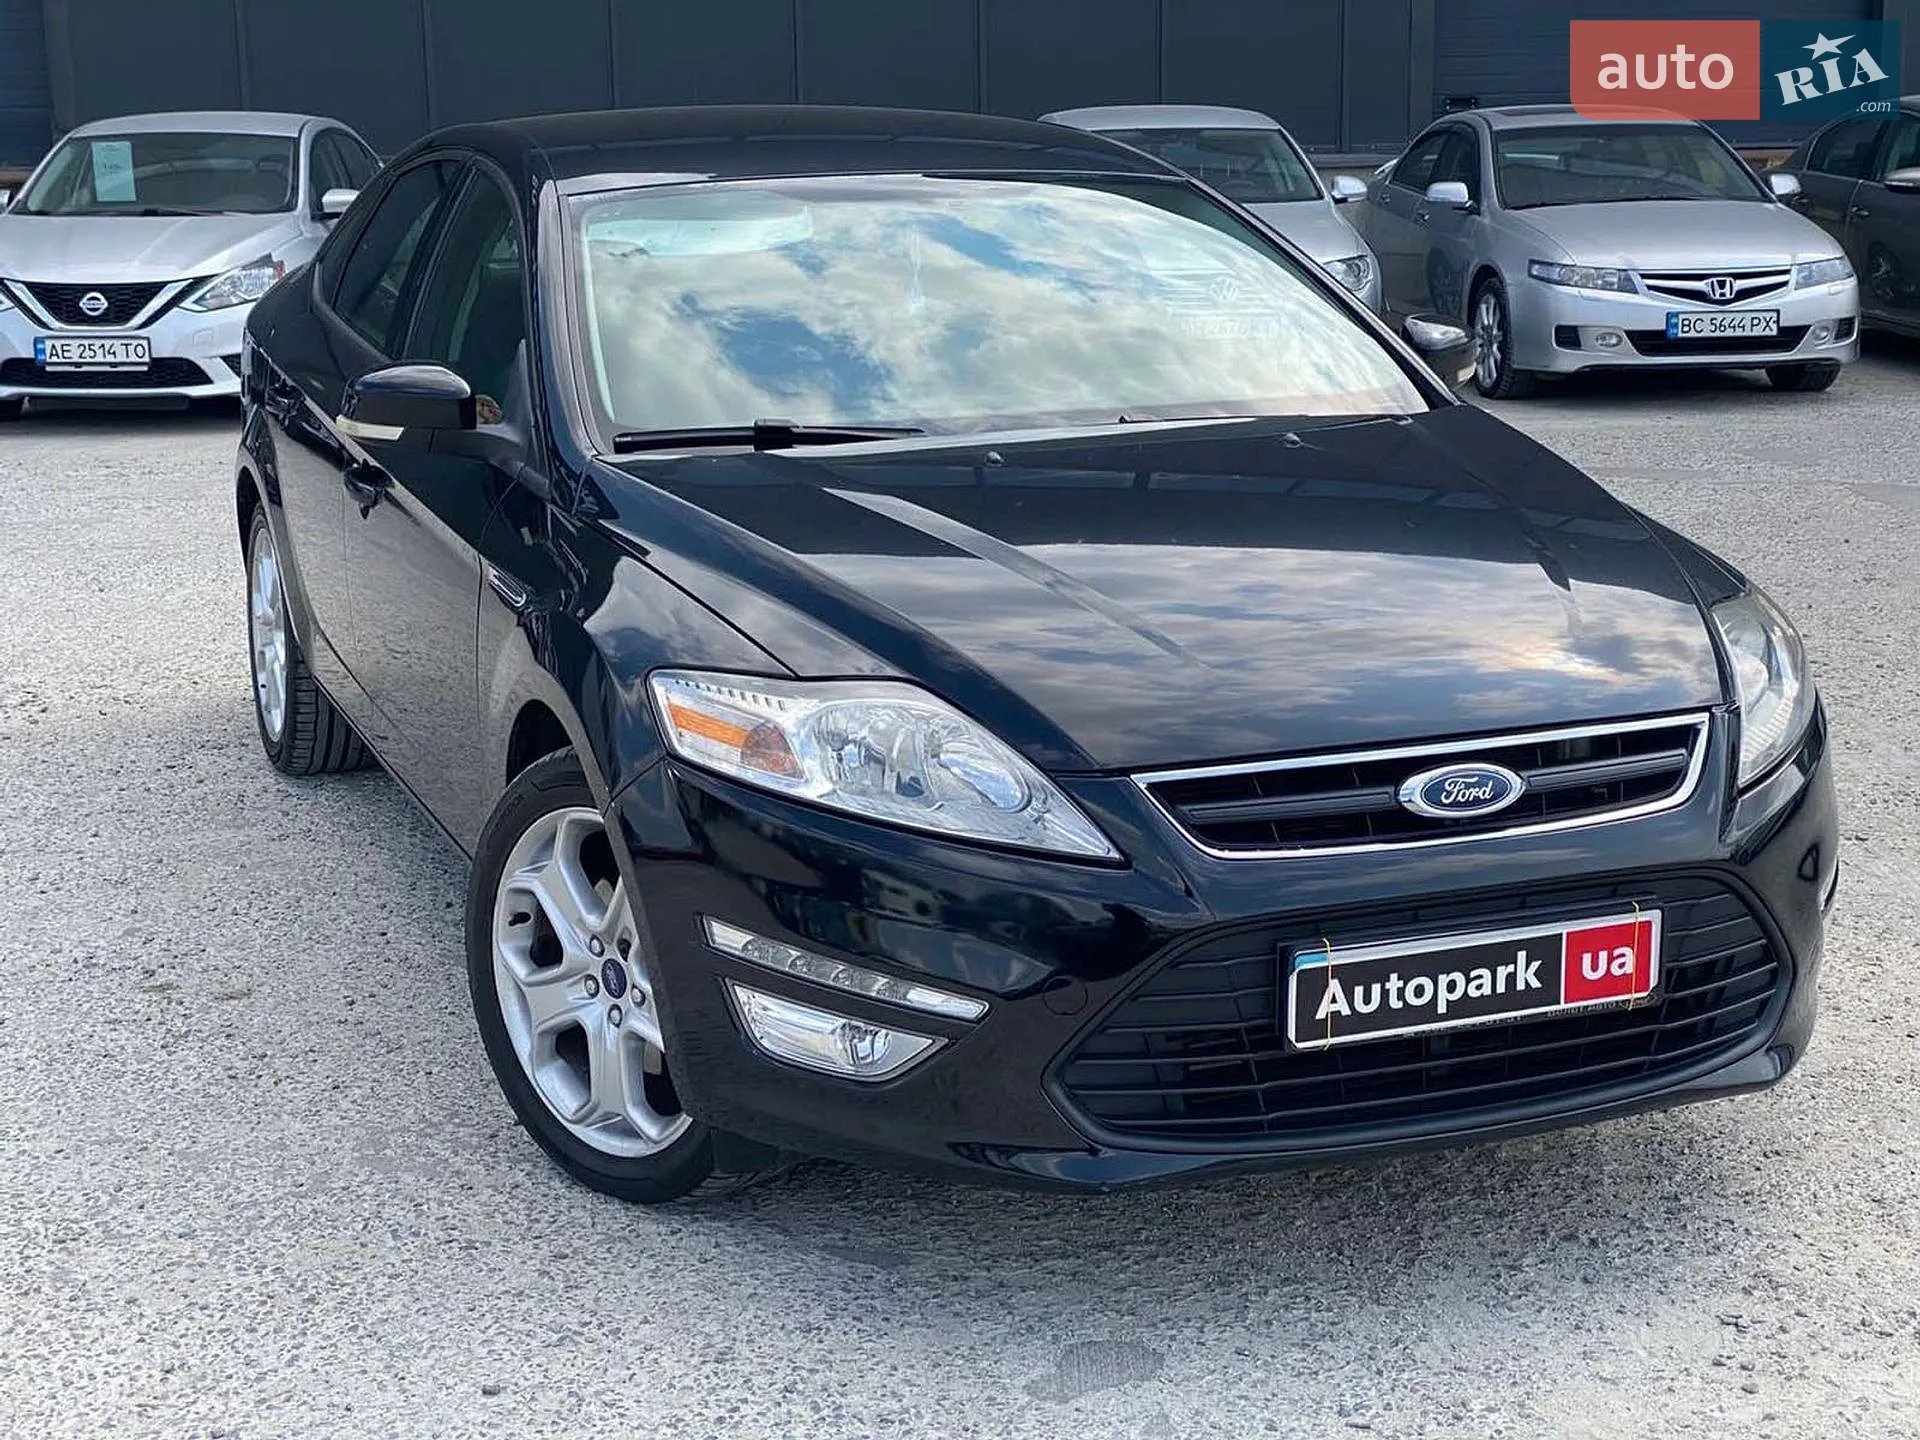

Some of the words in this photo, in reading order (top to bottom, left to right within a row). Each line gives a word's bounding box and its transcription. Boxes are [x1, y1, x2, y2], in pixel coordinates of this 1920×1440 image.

[1680, 317, 1704, 334] BC
[1709, 316, 1745, 334] 5644
[1750, 316, 1773, 333] PX
[49, 343, 72, 360] AE
[77, 343, 117, 360] 2514
[120, 343, 146, 359] TO
[1441, 776, 1494, 804] Ford
[1315, 950, 1543, 1020] Autopark
[1580, 945, 1634, 981] ua
